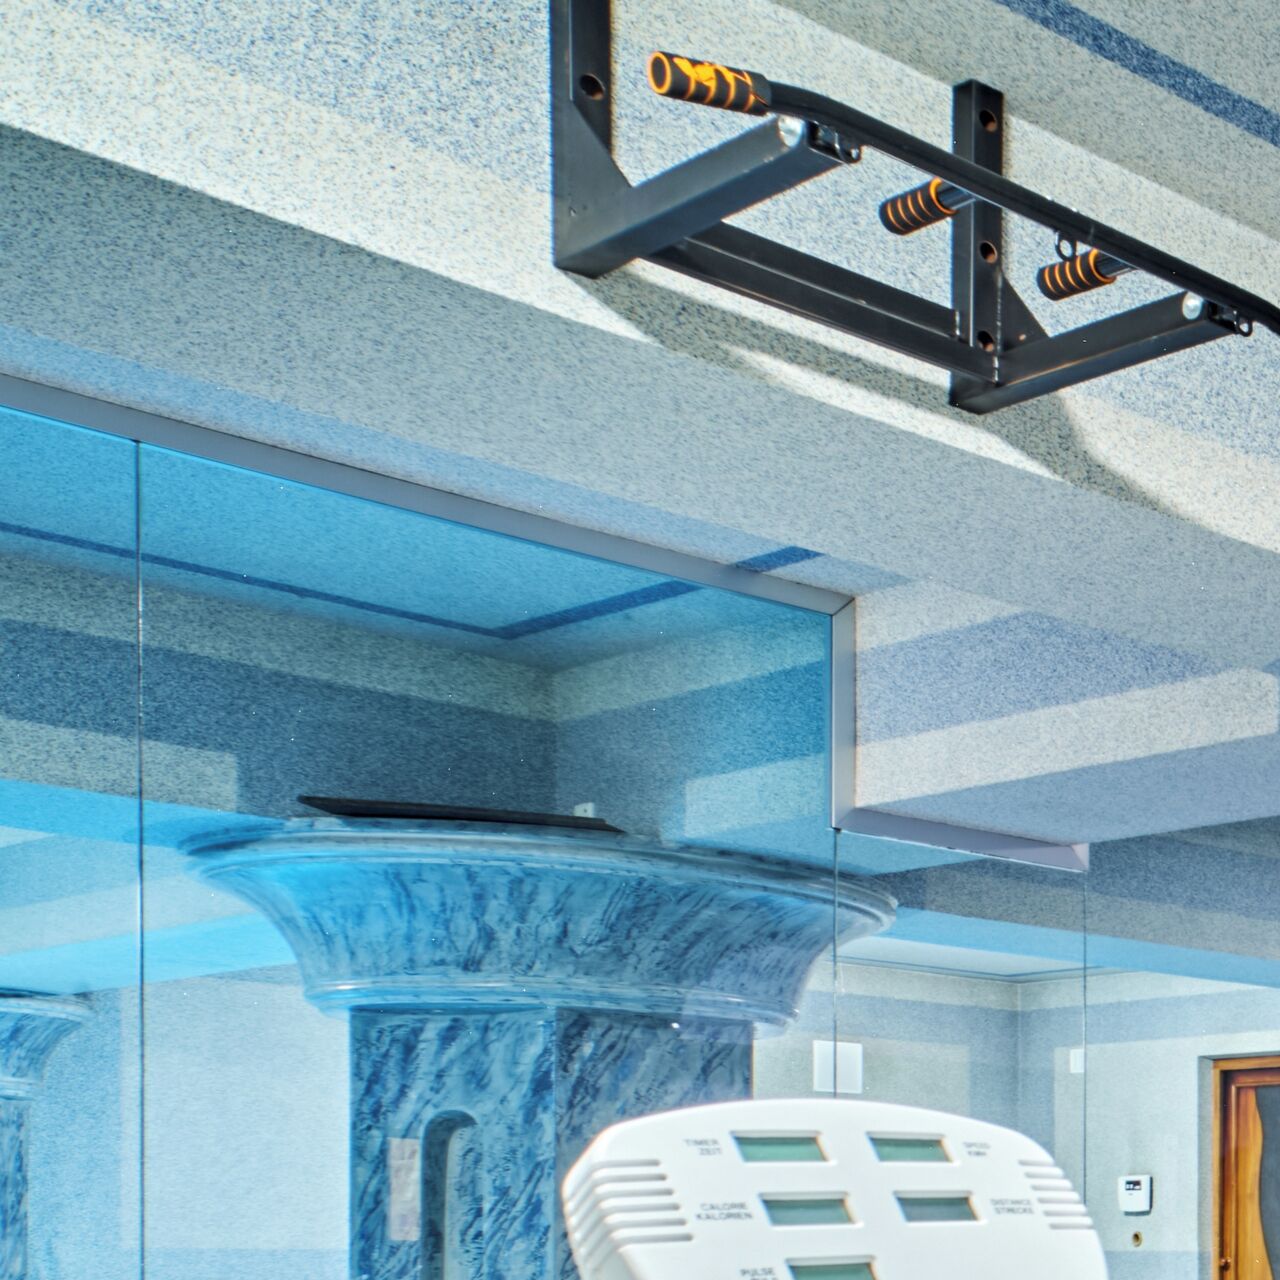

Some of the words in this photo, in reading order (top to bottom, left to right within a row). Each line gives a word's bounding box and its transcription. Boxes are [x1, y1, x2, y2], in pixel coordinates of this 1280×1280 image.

[683, 1138, 719, 1147] TIMER
[700, 1202, 748, 1211] CALORIE
[994, 1206, 1034, 1215] STRECKE
[695, 1211, 753, 1221] KALORIEN
[739, 1266, 775, 1277] PULSE
